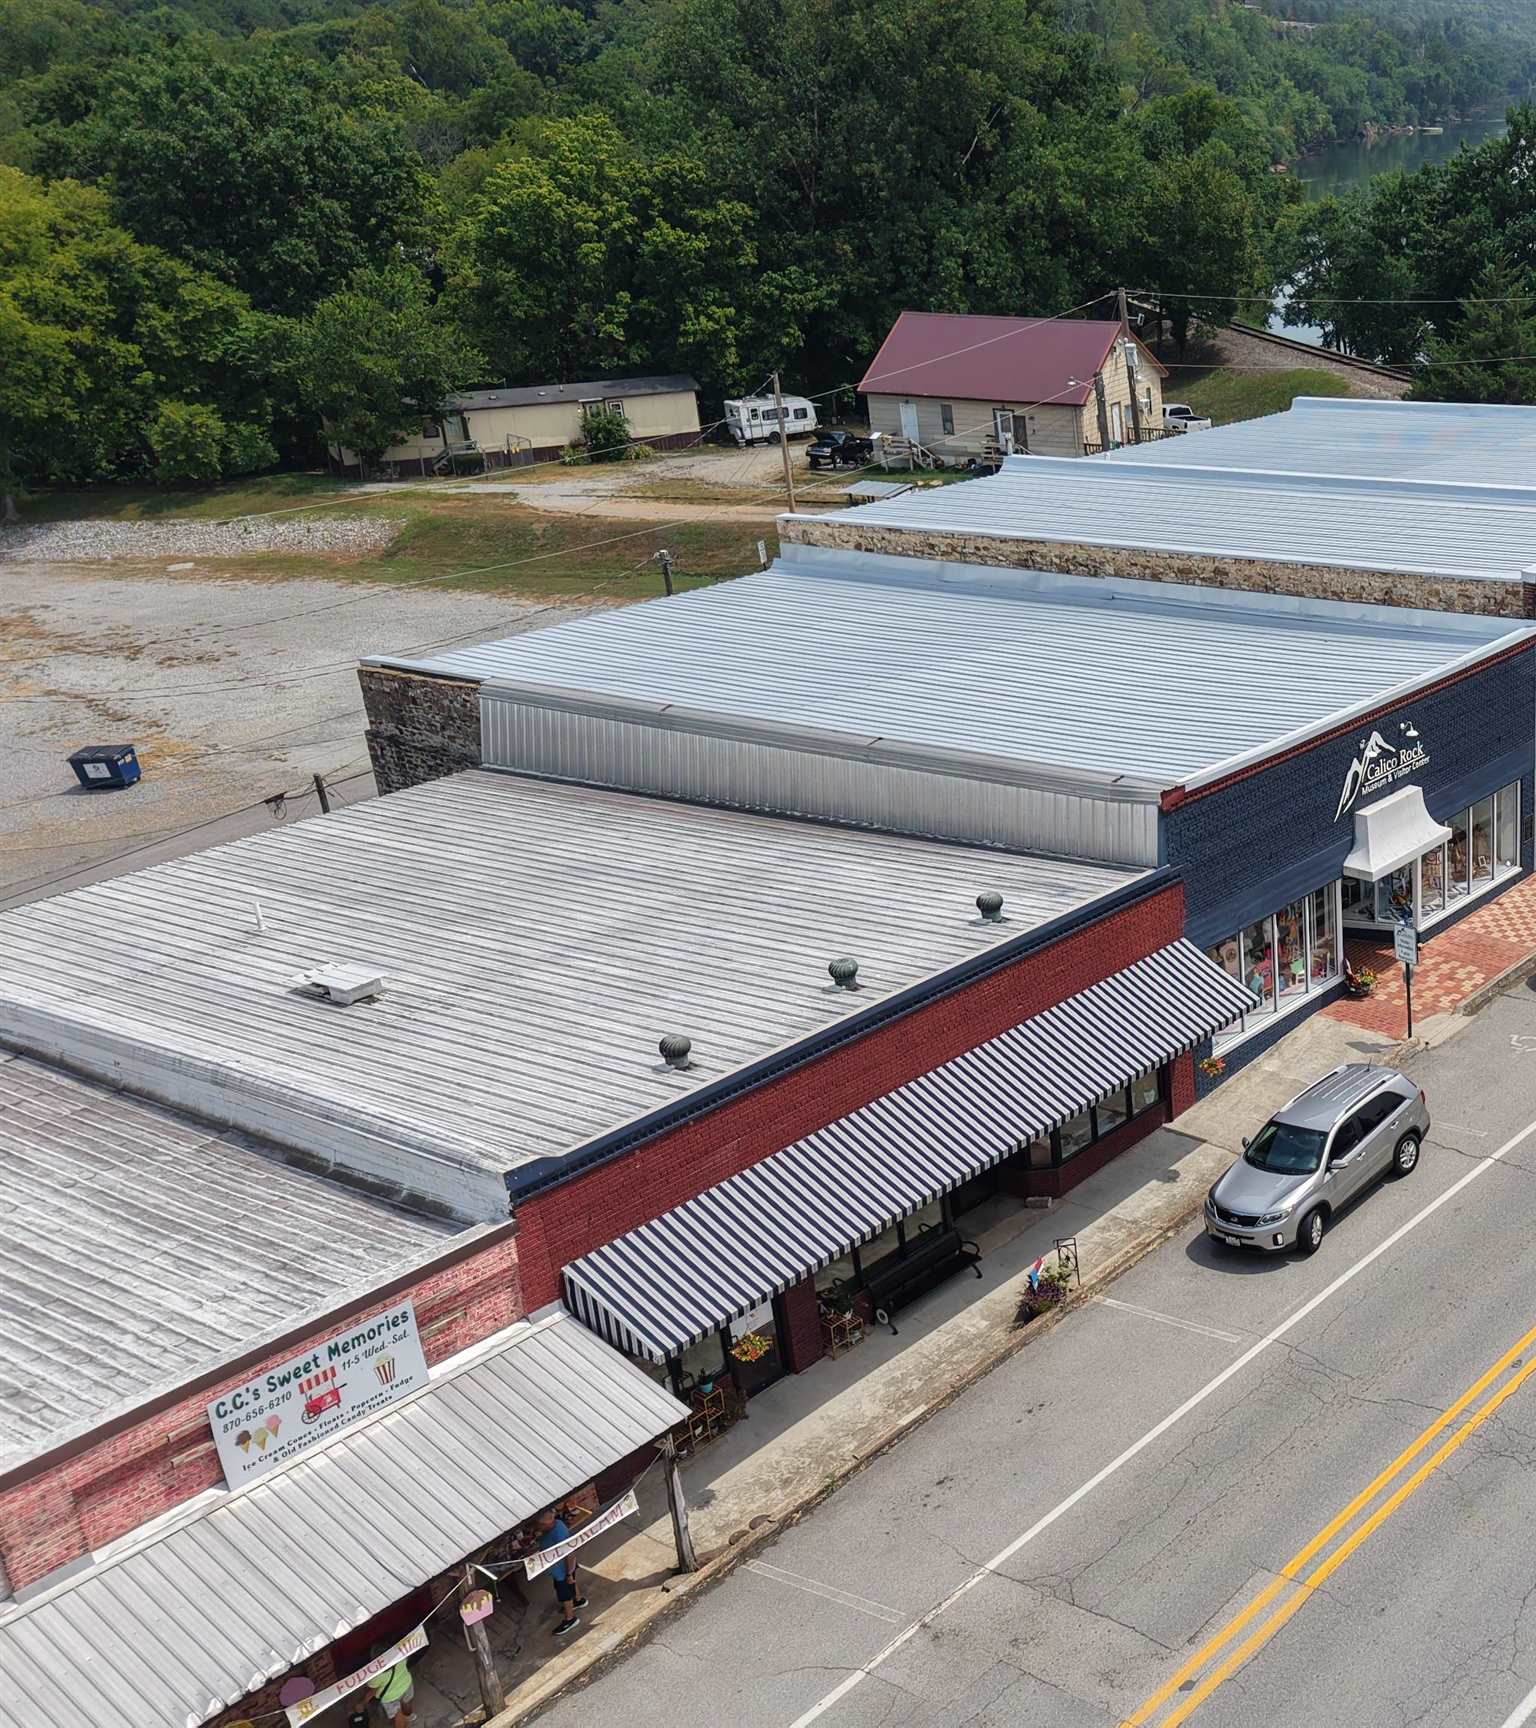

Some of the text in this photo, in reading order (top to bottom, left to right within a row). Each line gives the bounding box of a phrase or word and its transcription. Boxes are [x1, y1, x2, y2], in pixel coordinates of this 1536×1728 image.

[1361, 755, 1431, 796] Museum & Visitor Center
[1367, 740, 1424, 780] Calico Rock
[215, 1310, 409, 1420] C.C.'s Sweet Memories
[342, 1353, 360, 1371] 11-5
[222, 1390, 292, 1434] 870-656-6210
[242, 1376, 413, 1471] Ice Cream Cones Floats Popcorn Fudge
[281, 1448, 297, 1458] Old
[298, 1423, 339, 1449] Fashioned
[341, 1410, 366, 1425] Candy
[368, 1395, 393, 1411] Treats
[335, 1656, 388, 1695] FUDGE
